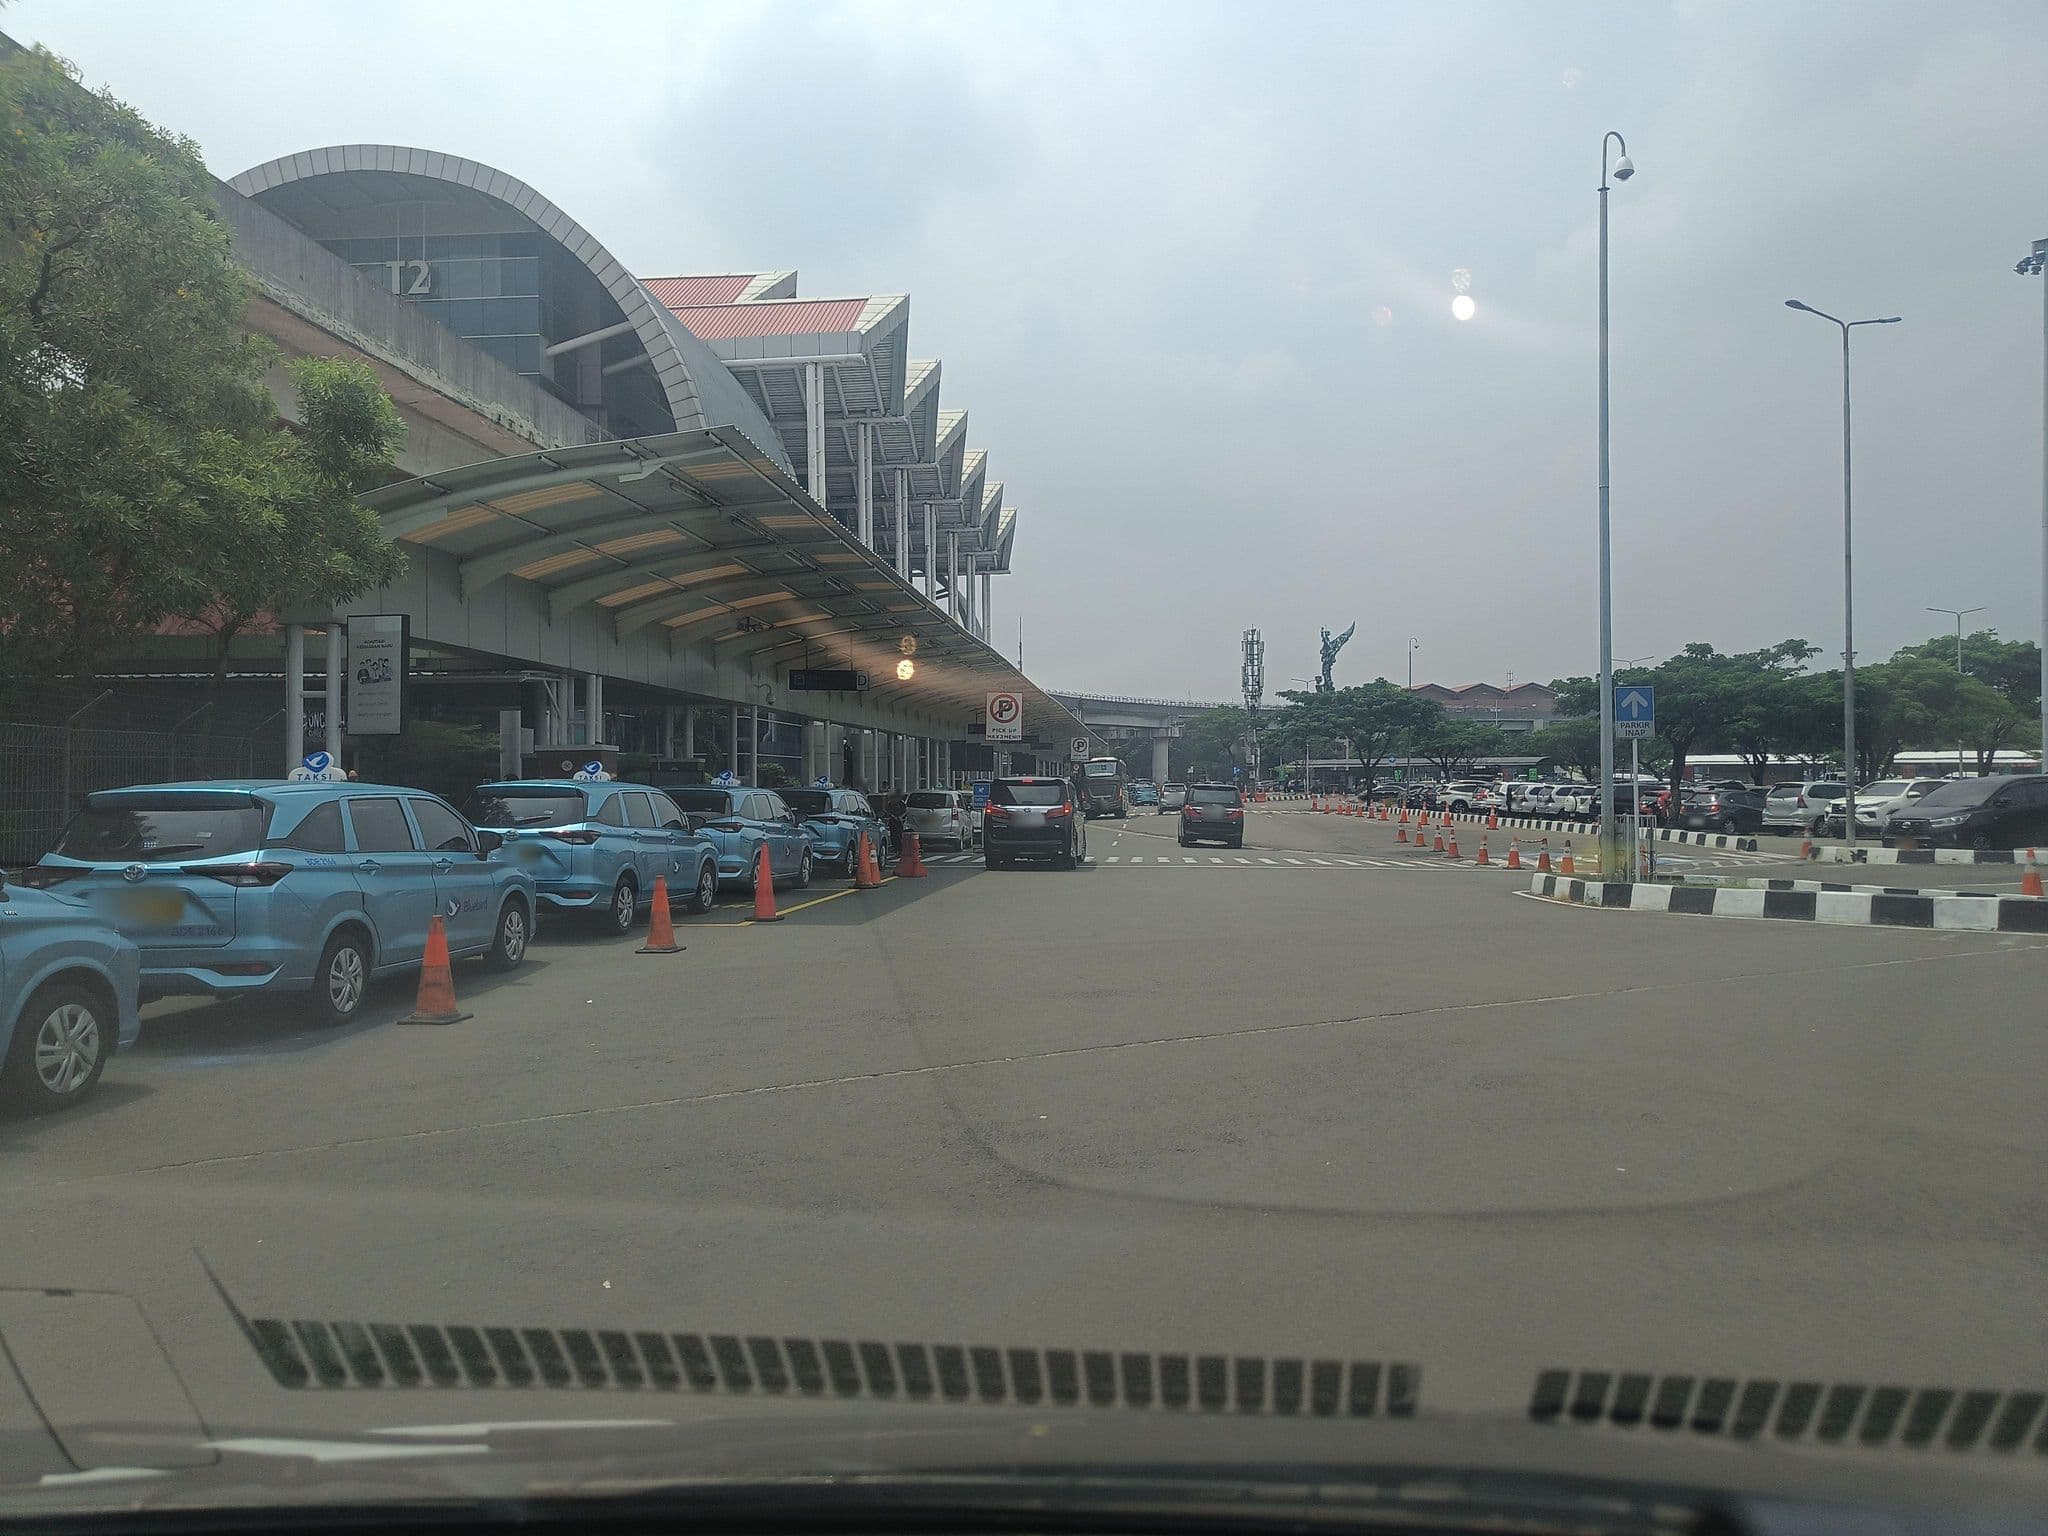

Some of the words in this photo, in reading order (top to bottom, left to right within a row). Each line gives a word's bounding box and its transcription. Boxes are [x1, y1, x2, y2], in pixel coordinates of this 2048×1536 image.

[385, 260, 431, 295] T2
[858, 674, 867, 686] D
[1620, 721, 1650, 729] PARKIR
[1625, 729, 1646, 737] INAP
[296, 773, 333, 782] TAKSI
